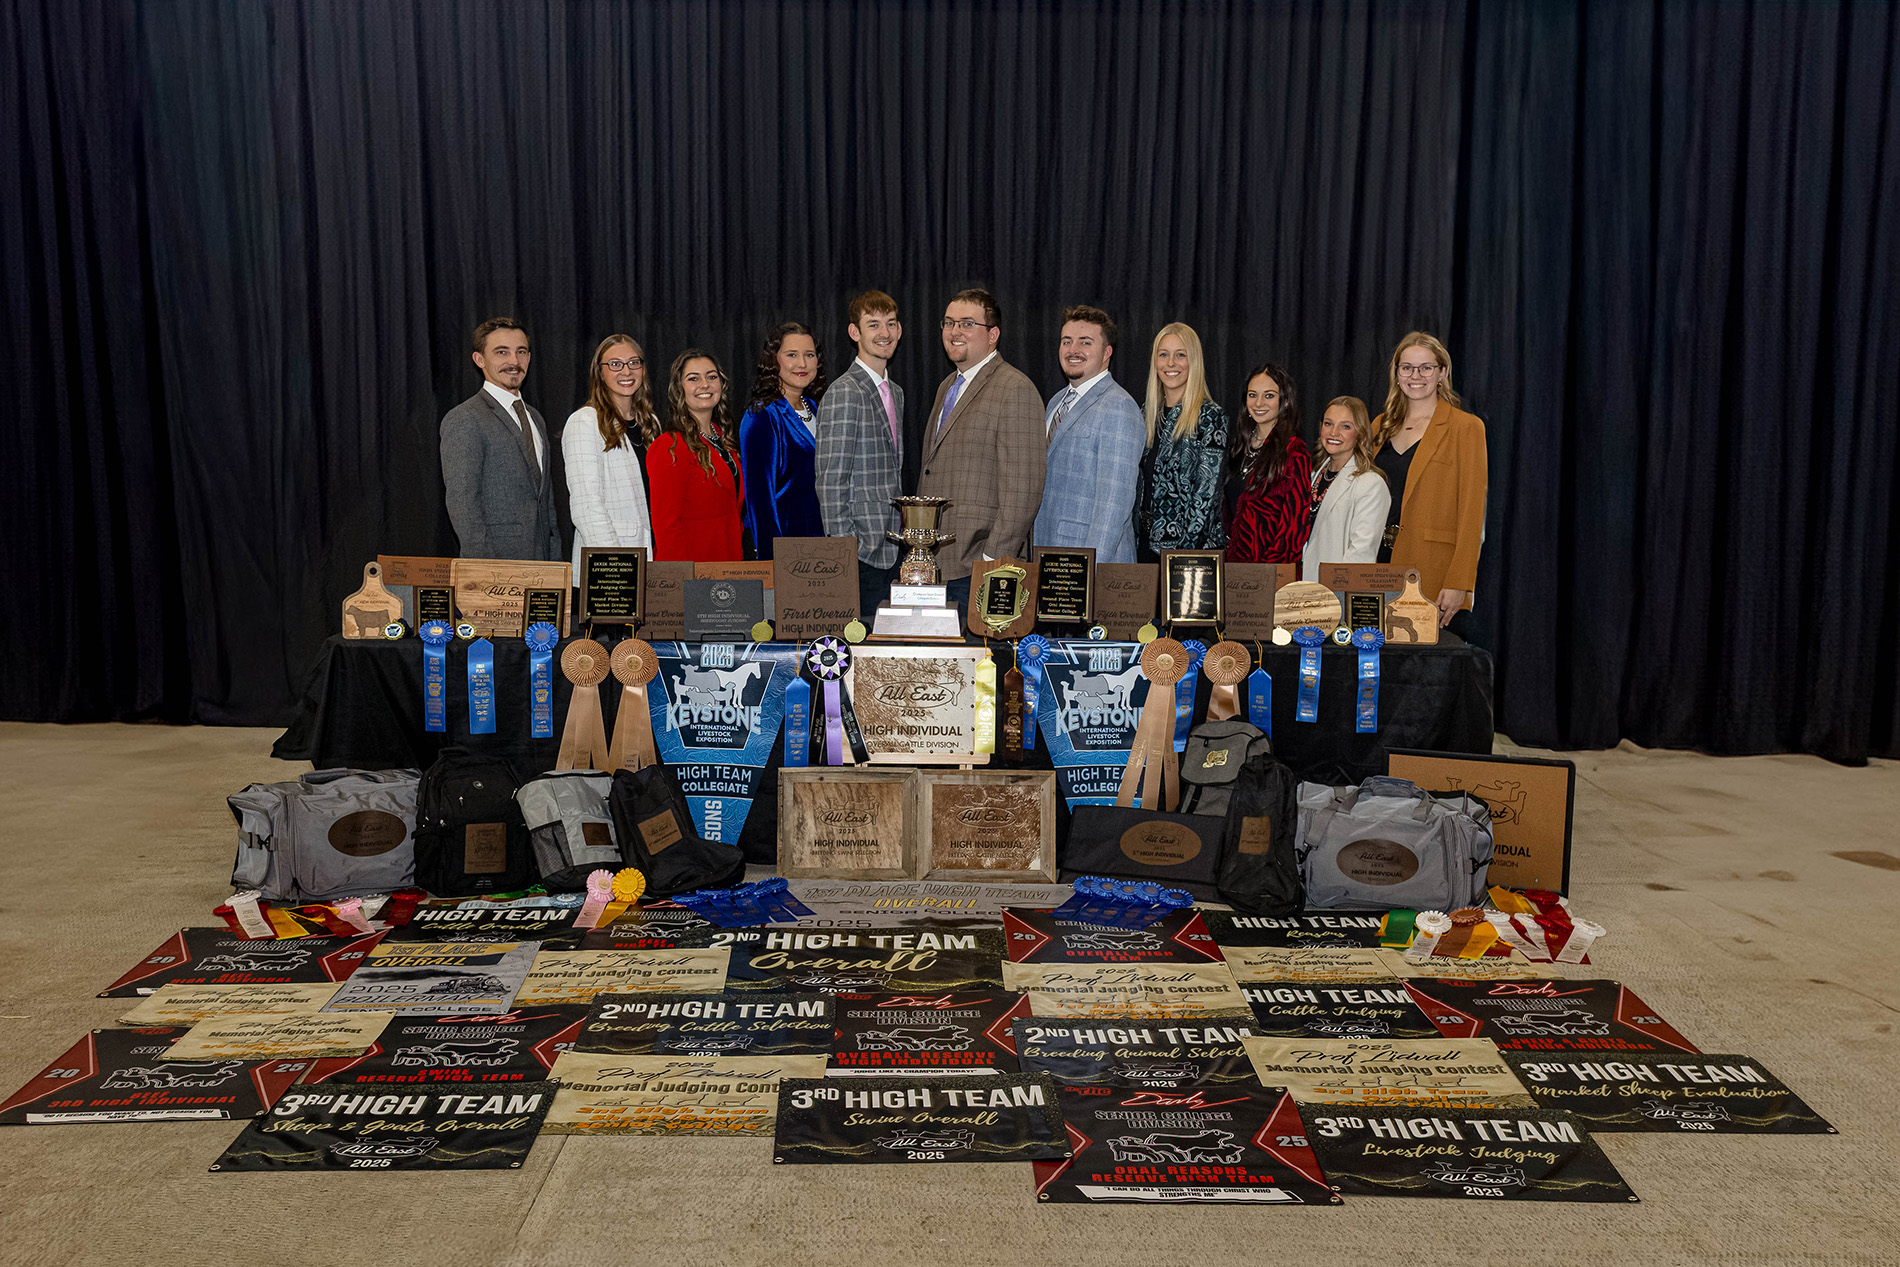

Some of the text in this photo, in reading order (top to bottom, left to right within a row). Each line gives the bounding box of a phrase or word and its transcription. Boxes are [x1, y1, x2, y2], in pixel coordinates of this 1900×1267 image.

[792, 561, 840, 574] All East
[782, 608, 855, 619] First Overall
[701, 644, 735, 667] 2025
[1089, 648, 1122, 672] 2025
[879, 686, 946, 702] All East
[666, 703, 761, 734] KEYSTONE
[864, 726, 962, 736] HIGH INDIVIDUAL
[677, 766, 752, 783] HIGH TEAM
[682, 782, 748, 794] COLLEGIATE
[950, 841, 1024, 849] HIGH INDIVIDUAL
[873, 898, 980, 909] OVERALL
[413, 910, 564, 921] HIGH TEAM
[479, 922, 548, 931] Overall
[798, 919, 872, 928] 2025
[1231, 916, 1381, 929] HIGH TEAM
[711, 932, 976, 950] 2ND HIGH TEAM
[147, 956, 176, 964] 20
[371, 957, 467, 967] OVERALL
[749, 950, 938, 972] Overall
[585, 968, 719, 979] Judging Contest
[349, 985, 418, 994] 2025
[1016, 985, 1231, 994] Memorial Judging Contest
[1241, 989, 1415, 1003] HIGH TEAM
[599, 1000, 825, 1019] 2ND HIGH TEAM
[1436, 1016, 1464, 1024] 20
[1632, 1016, 1662, 1024] 25
[1024, 1028, 1250, 1044] 2ND HIGH TEAM
[836, 1052, 912, 1060] OVERALL
[45, 1068, 79, 1079] 20
[274, 1063, 306, 1074] 25
[1266, 1064, 1508, 1076] Memorial Judging Contest
[1520, 1061, 1767, 1083] 3RD HIGH TEAM
[356, 1074, 427, 1083] RESERVE
[434, 1073, 474, 1082] HIGH
[558, 1082, 732, 1095] Memorial Judging
[1532, 1082, 1790, 1100] Market Sheep Evaluation
[791, 1086, 1045, 1109] 3RD HIGH TEAM
[274, 1094, 543, 1116] 3RD HIGH TEAM
[634, 1106, 694, 1114] High
[844, 1112, 999, 1126] Swine Overall
[1314, 1117, 1581, 1143] 3RD HIGH TEAM
[1677, 1121, 1716, 1131] 2025
[1276, 1136, 1308, 1146] 25
[907, 1150, 944, 1160] 2025
[1362, 1143, 1560, 1164] Livestock Judging
[350, 1159, 392, 1168] 2025
[1115, 1166, 1248, 1175] ORAL REASONS
[1092, 1174, 1275, 1184] RESERVE HIGH TEAM
[1462, 1186, 1504, 1196] 2025
